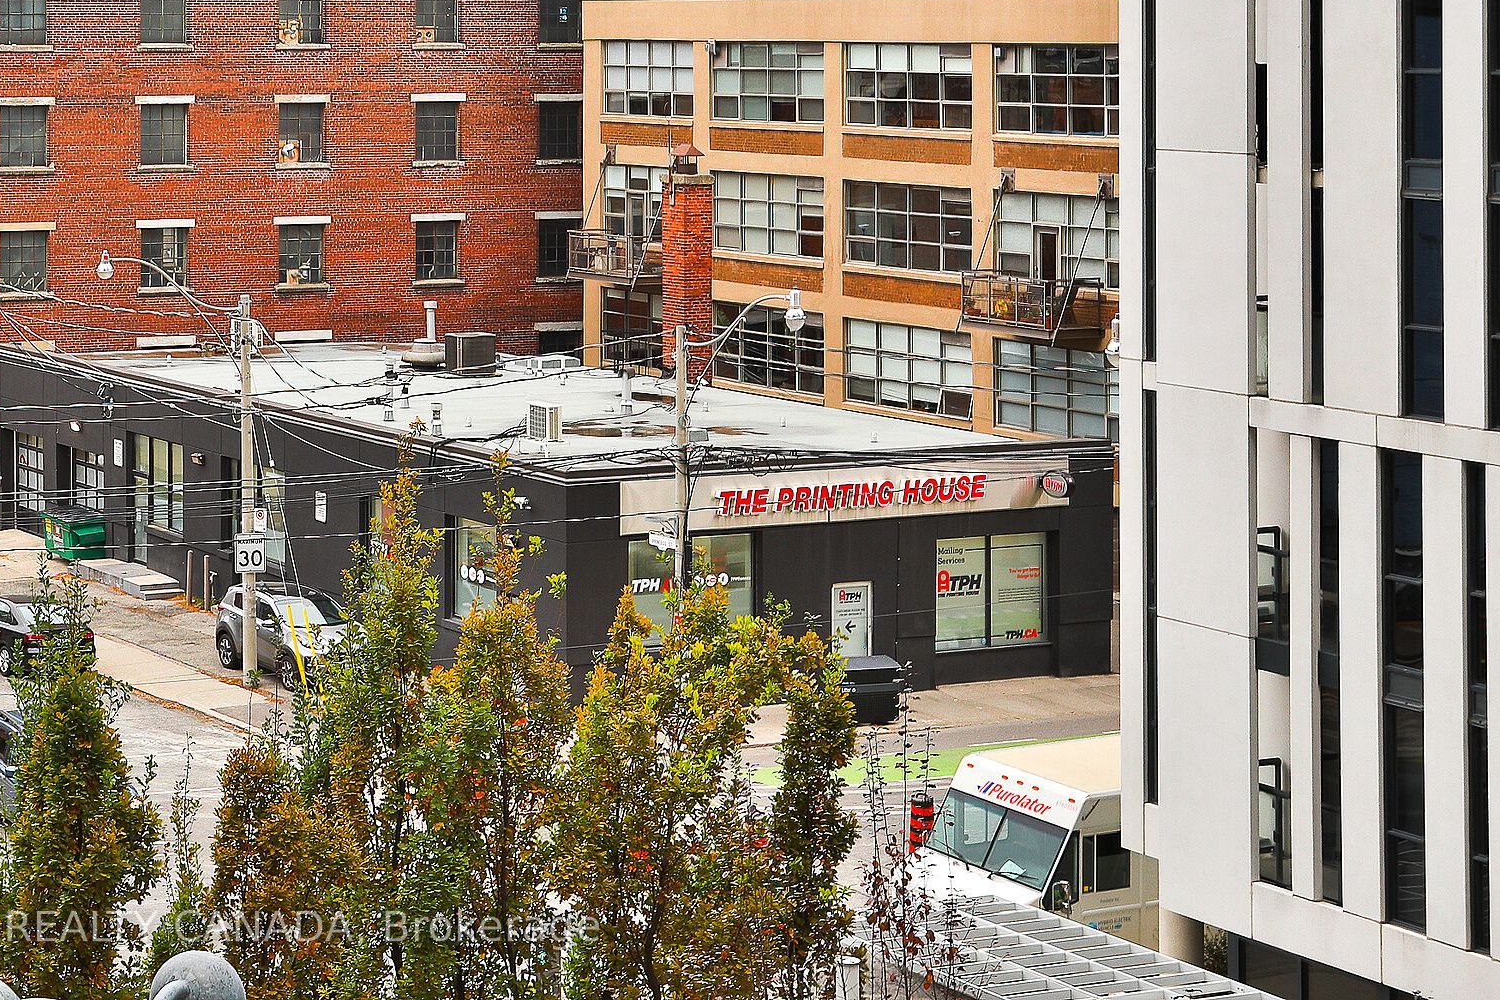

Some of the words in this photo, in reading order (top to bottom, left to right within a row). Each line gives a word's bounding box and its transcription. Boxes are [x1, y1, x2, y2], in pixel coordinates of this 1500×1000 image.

[717, 488, 770, 516] THE
[774, 480, 896, 513] PRINTING
[901, 474, 987, 504] HOUSE
[238, 549, 263, 567] 30
[938, 547, 964, 556] Mailing
[938, 557, 965, 565] Services
[950, 574, 982, 590] TPH
[845, 591, 862, 600] TPH
[1005, 628, 1039, 640] TPH.CA
[987, 783, 1052, 815] Purolator
